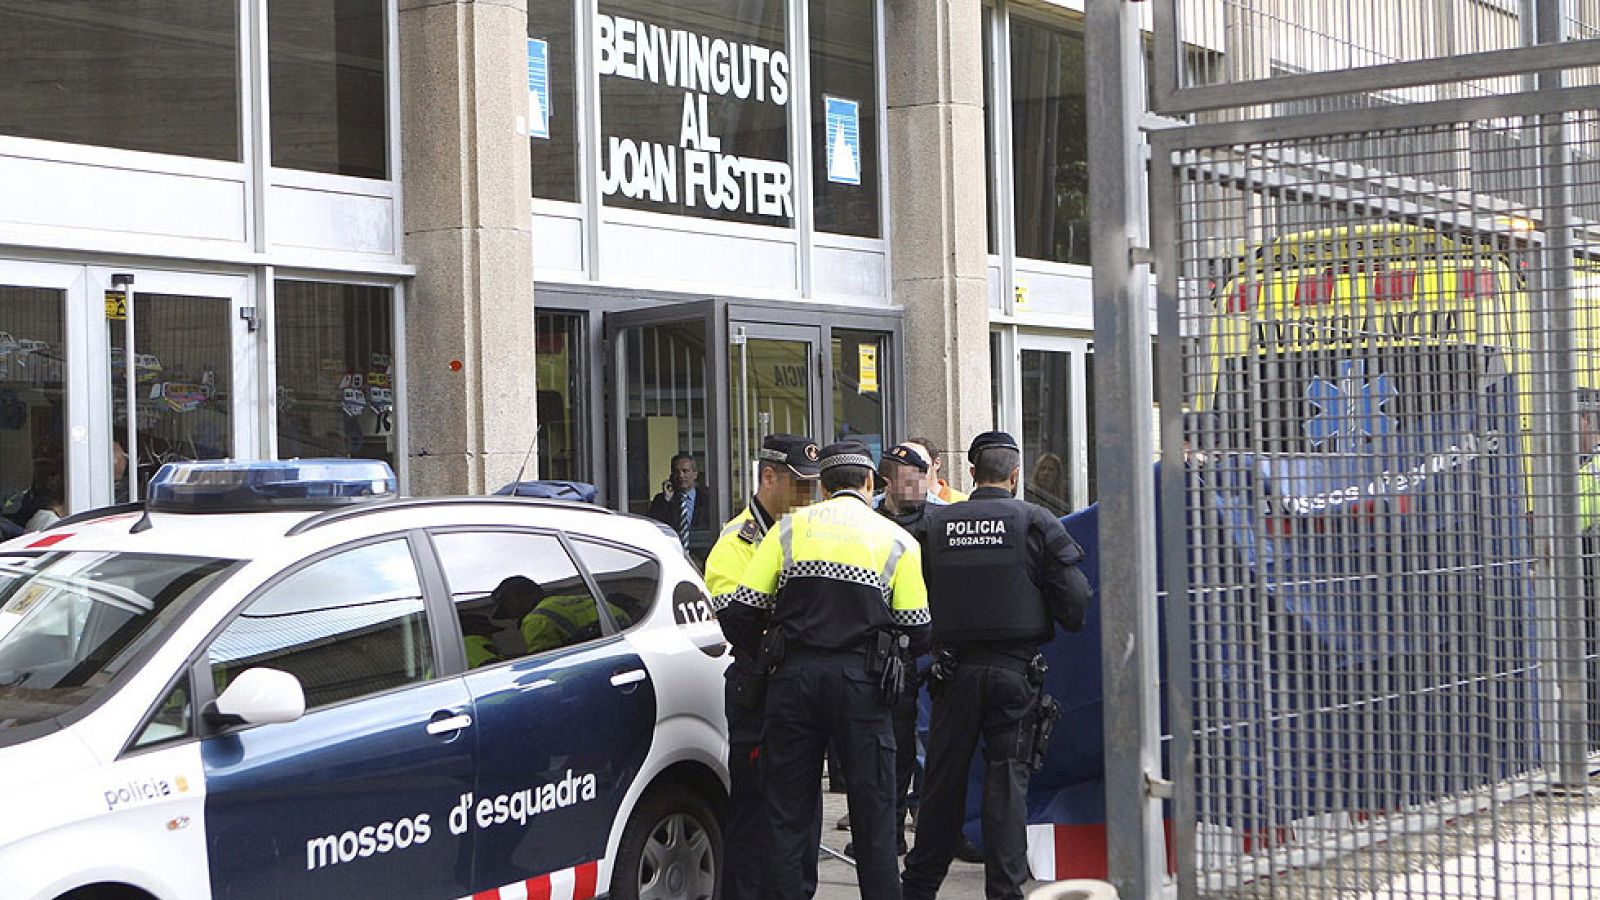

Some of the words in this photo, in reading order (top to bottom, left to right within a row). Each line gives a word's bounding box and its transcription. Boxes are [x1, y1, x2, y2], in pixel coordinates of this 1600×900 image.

[598, 14, 789, 106] BENVINGUTS
[680, 93, 721, 152] AL
[602, 136, 677, 204] JOAN
[685, 150, 794, 218] FUSTER
[945, 519, 1007, 537] POLICIA
[677, 600, 712, 625] 112
[104, 776, 171, 811] policia
[305, 811, 431, 870] mossos
[448, 768, 597, 835] d'esquadra
